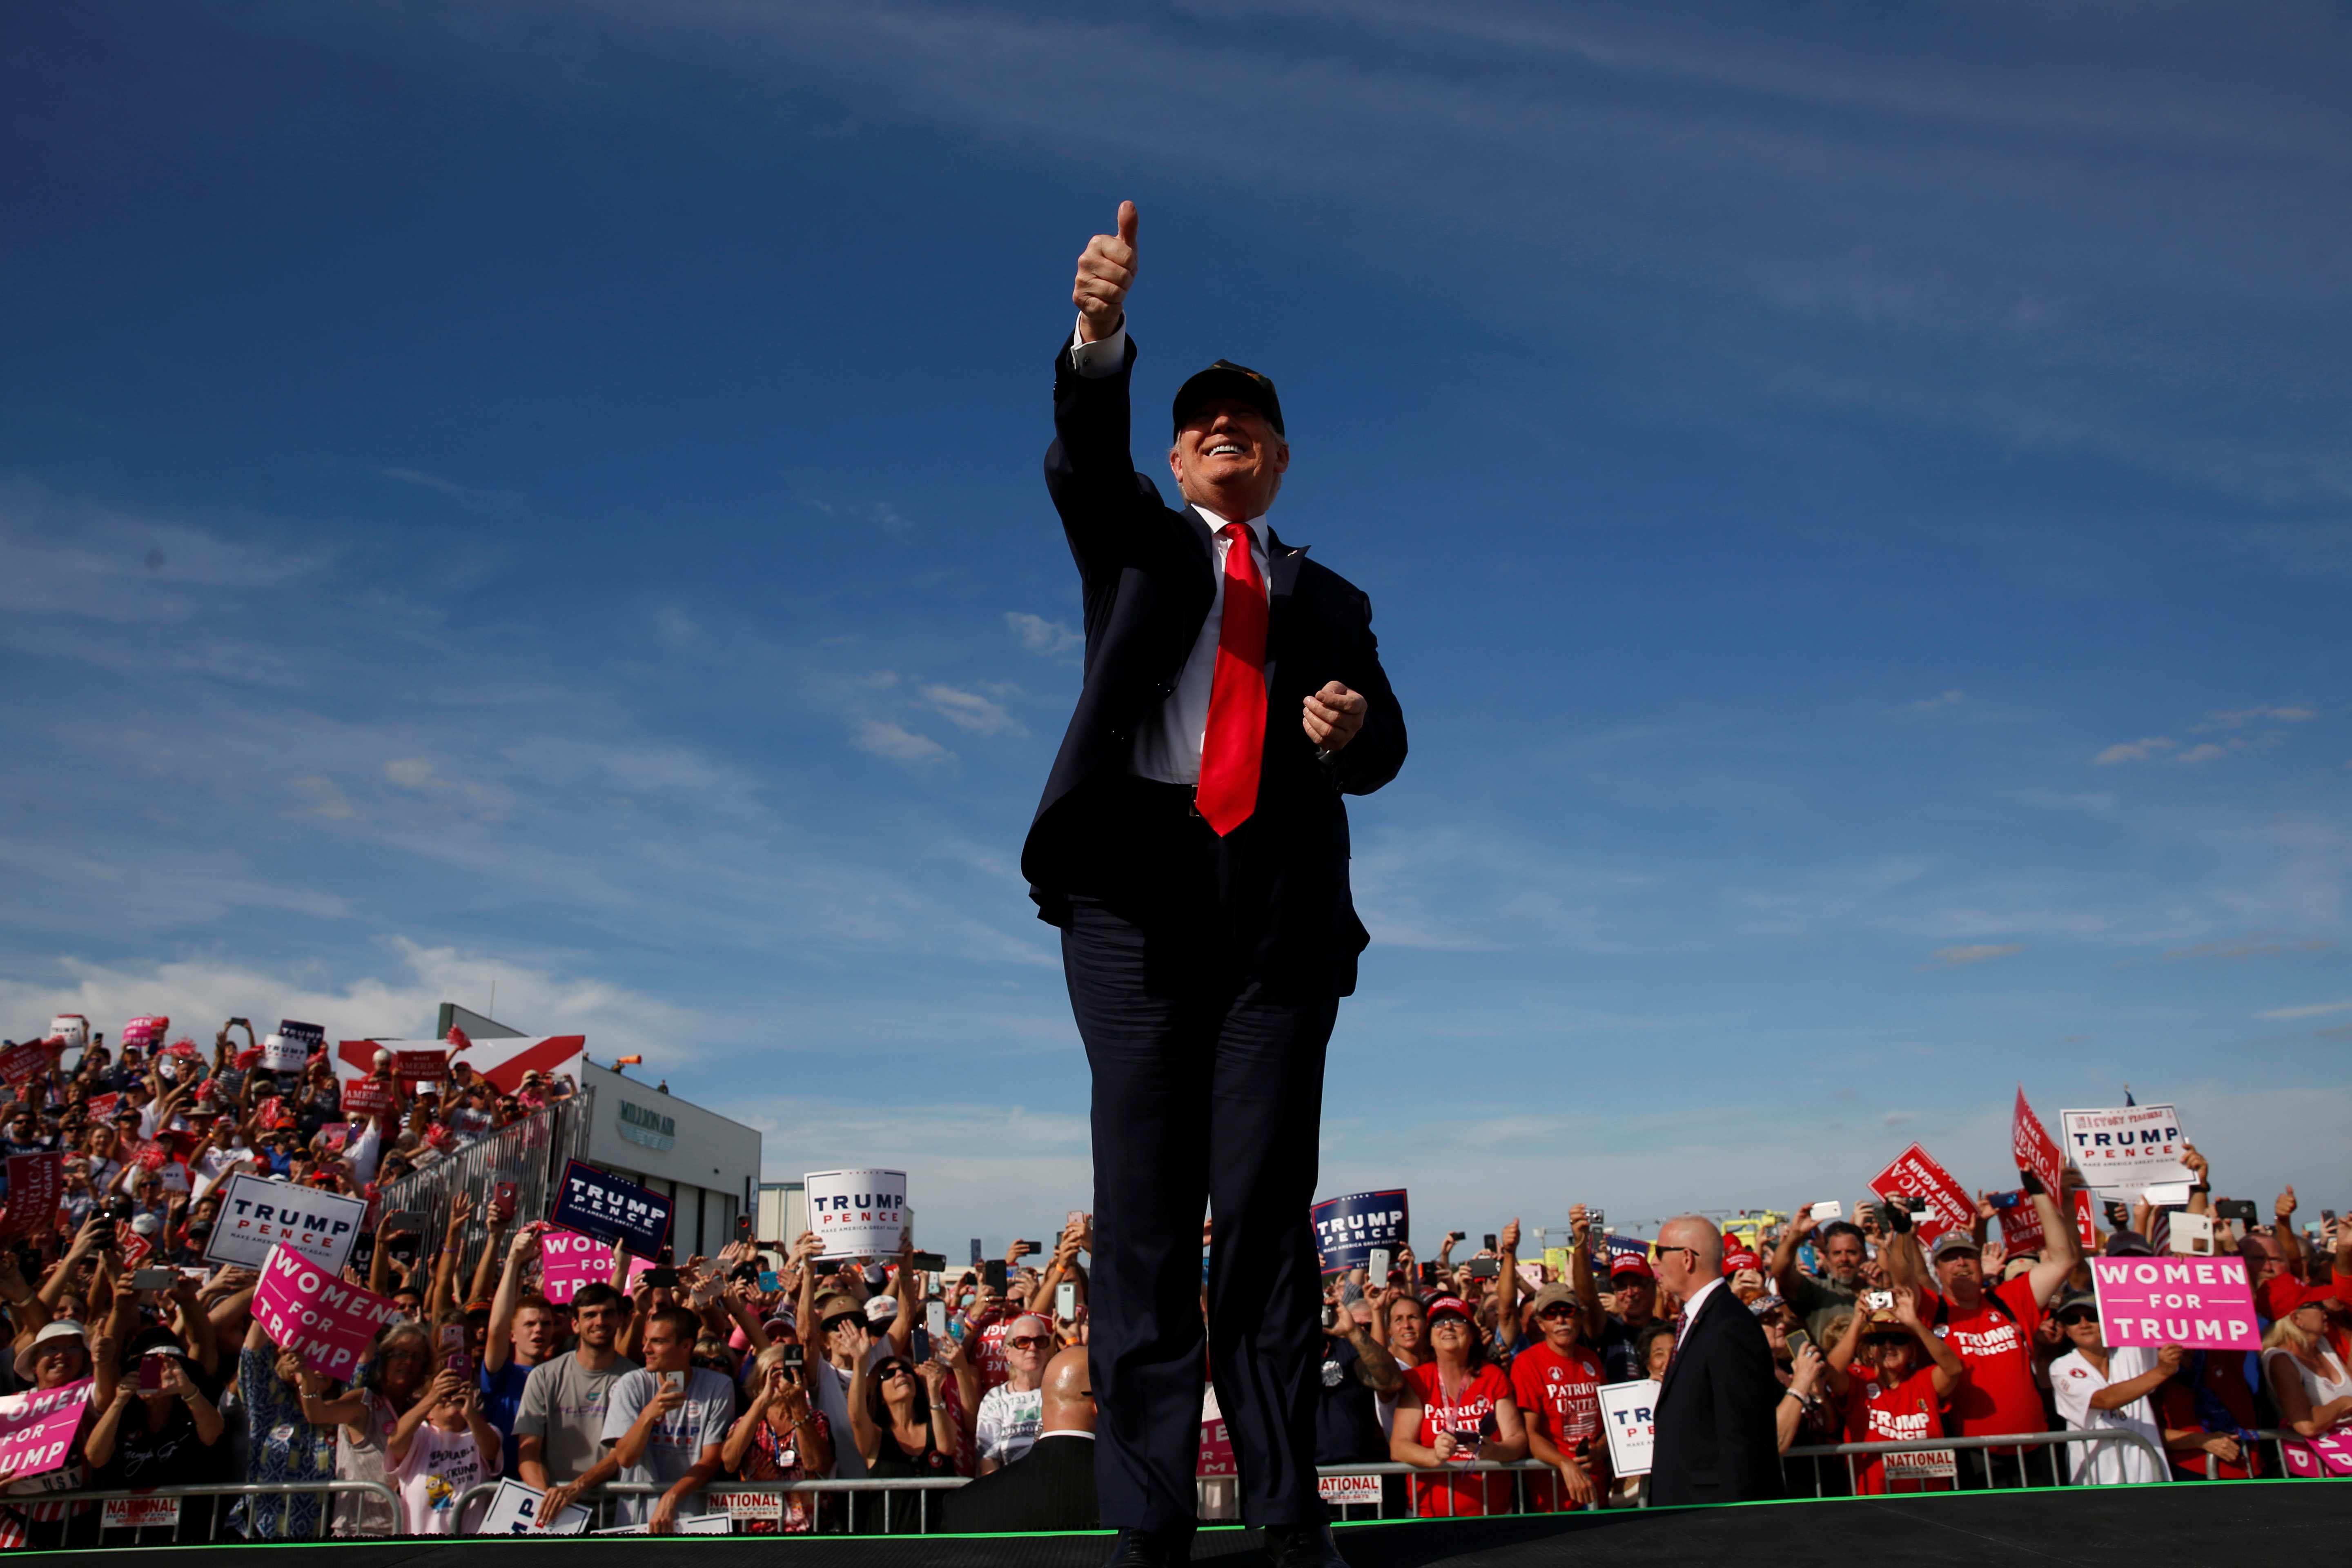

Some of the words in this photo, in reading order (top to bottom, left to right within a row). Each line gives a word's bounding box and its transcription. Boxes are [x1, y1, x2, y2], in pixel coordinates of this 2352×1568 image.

[619, 1100, 660, 1131] MILLION
[660, 1116, 675, 1137] AIR
[2073, 1127, 2178, 1146] TRUMP
[2085, 1145, 2173, 1158] PENCE
[1906, 1158, 1941, 1191] AGAIN
[570, 1177, 666, 1219] TRUMP
[814, 1194, 903, 1212] TRUMP
[1936, 1190, 1968, 1222] GREAT
[234, 1199, 350, 1235] TRUMP
[569, 1204, 585, 1213] MAKE
[586, 1209, 613, 1222] AMERICA
[614, 1218, 633, 1228] GREAT
[574, 1194, 654, 1228] PENCE
[823, 1212, 898, 1224] PENCE
[237, 1219, 334, 1248] PENCE
[1316, 1210, 1403, 1236] TRUMP
[230, 1232, 250, 1241] MAKE
[252, 1237, 281, 1246] AMERIC
[1324, 1227, 1396, 1246] PENCE
[1338, 1242, 1363, 1251] AMERICA
[2098, 1263, 2246, 1285] WOMEN
[275, 1248, 393, 1323] WOMEN
[2149, 1293, 2202, 1309] FOR
[288, 1301, 333, 1332] FOR
[261, 1296, 351, 1368] TRUMP
[1953, 1325, 2016, 1347] TRUMP
[2113, 1318, 2249, 1341] TRUMP
[1961, 1339, 2018, 1356] PENCE
[7, 1382, 93, 1422] OMEN
[1868, 1420, 1927, 1441] PENCE
[1869, 1409, 1930, 1430] TRUMP
[2, 1423, 46, 1447] FOR
[0, 1441, 65, 1474] UMP
[1885, 1451, 1953, 1467] NATIONAL
[42, 1472, 80, 1490] USA
[446, 1463, 479, 1479] TRUMP
[1317, 1476, 1379, 1491] ATIONAL
[106, 1498, 176, 1514] NATIONAL
[709, 1493, 778, 1507] NATIONAL
